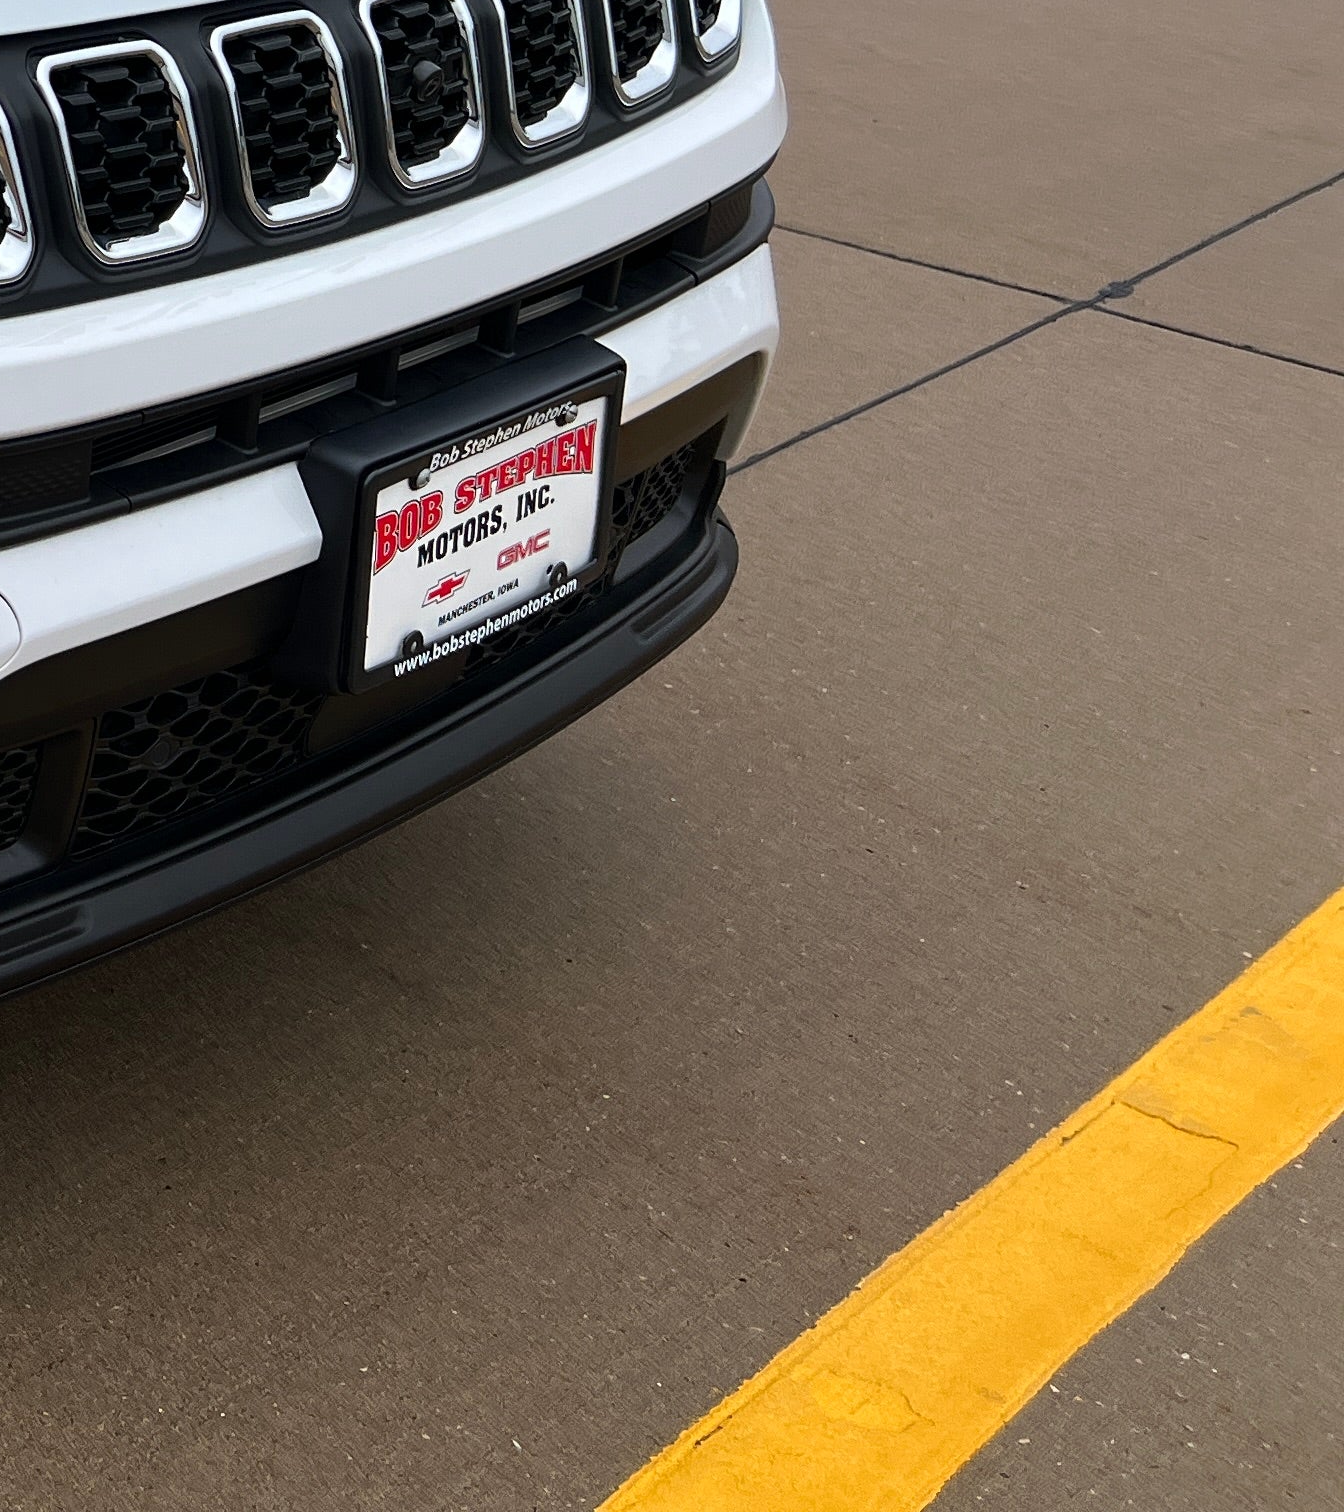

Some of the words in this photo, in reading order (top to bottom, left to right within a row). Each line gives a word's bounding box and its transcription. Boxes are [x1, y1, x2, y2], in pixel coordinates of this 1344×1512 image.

[430, 446, 459, 472] Bob
[461, 423, 522, 460] Stephen
[522, 400, 572, 433] Motors
[373, 490, 444, 575] BOB
[454, 419, 598, 515] STEPHEN
[417, 505, 508, 568] MOTORS,
[515, 485, 556, 522] INC.
[497, 528, 551, 570] GMC
[394, 578, 577, 677] www.bobstephenmotors.com
[438, 590, 495, 627] MANCHESTER,
[497, 578, 520, 597] IOWA
